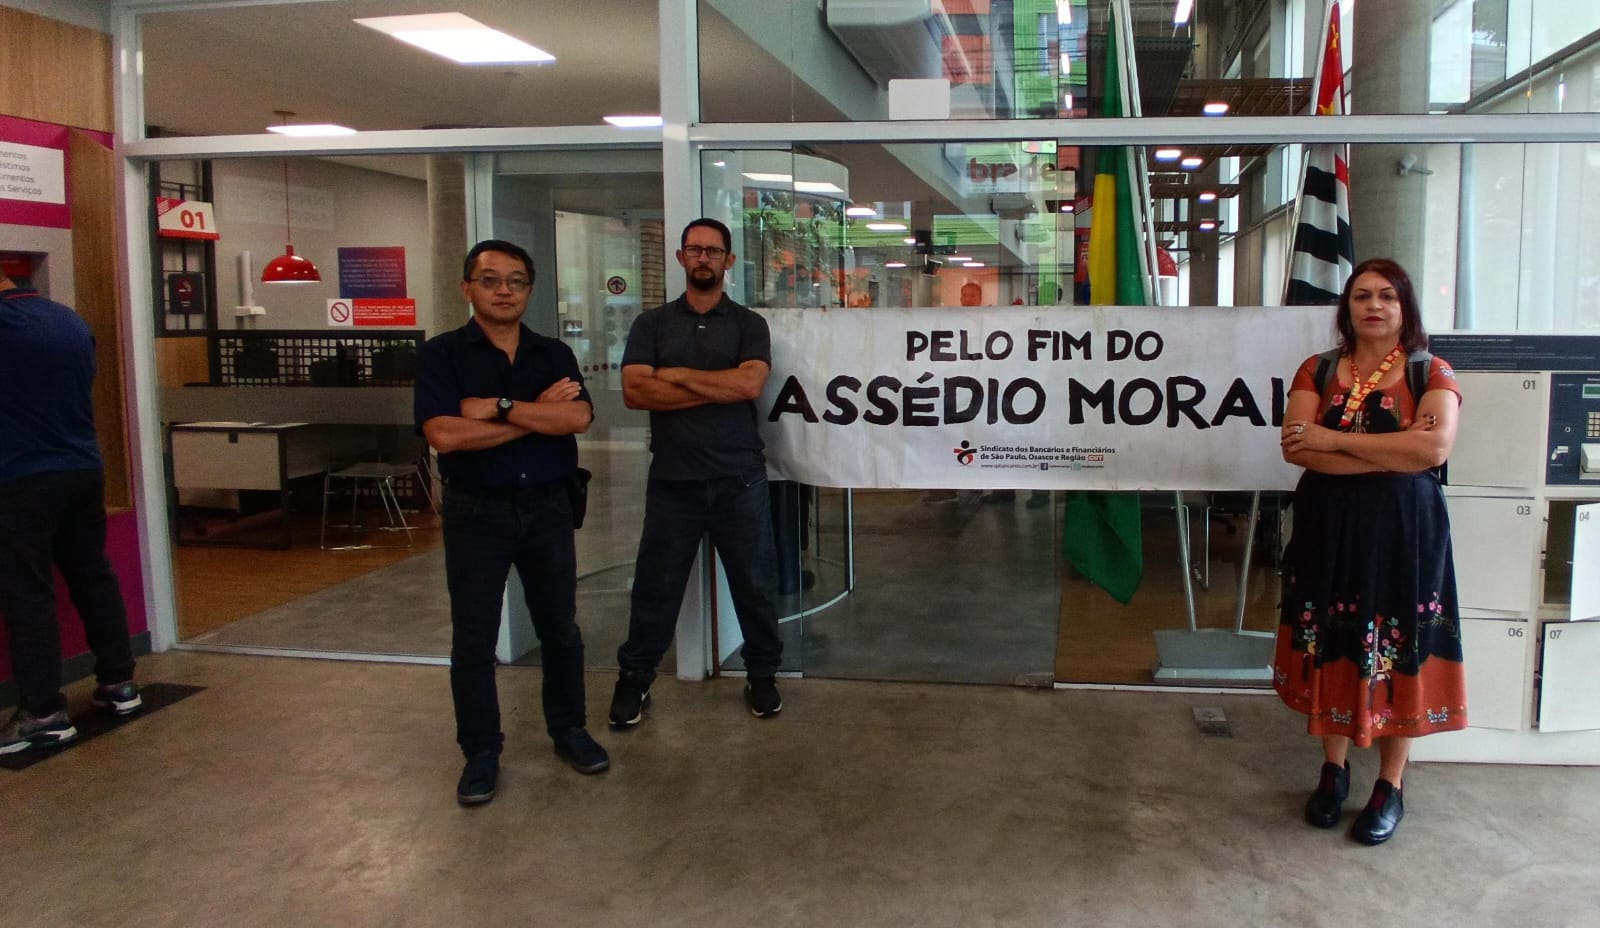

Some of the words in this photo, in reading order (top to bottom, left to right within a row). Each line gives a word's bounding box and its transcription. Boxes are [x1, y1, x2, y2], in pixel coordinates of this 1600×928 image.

[180, 209, 205, 230] 01
[906, 329, 1014, 362] PELO
[1027, 329, 1093, 362] FIM
[1106, 329, 1164, 362] DO
[1522, 380, 1536, 390] 01
[767, 371, 1047, 427] ASSÉDIO
[1072, 446, 1116, 454] Financiários
[1061, 454, 1086, 462] Região
[1516, 505, 1531, 516] 03
[1579, 511, 1590, 522] 04
[1508, 627, 1523, 638] 06
[1550, 630, 1562, 640] 07
